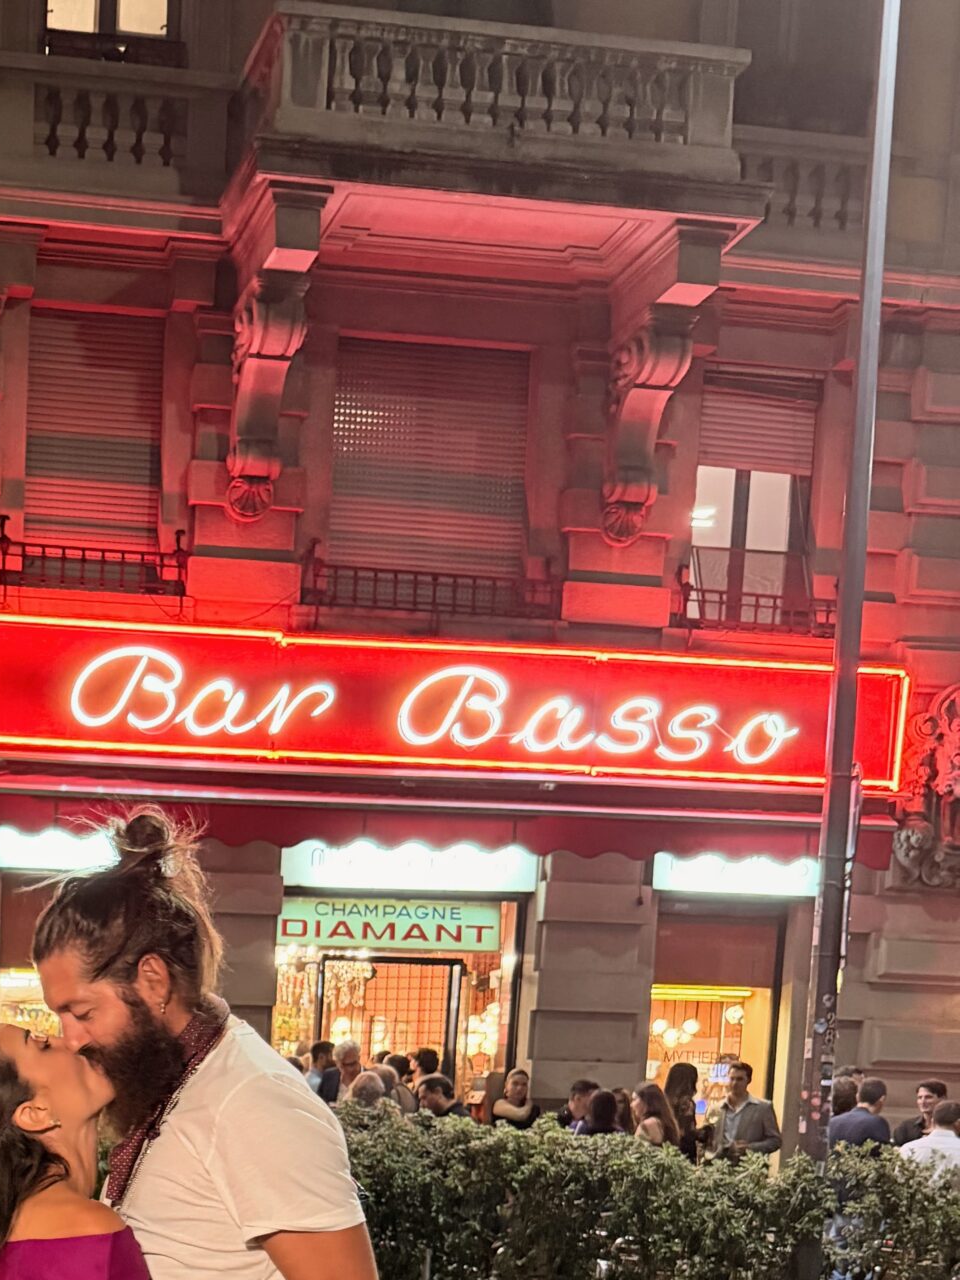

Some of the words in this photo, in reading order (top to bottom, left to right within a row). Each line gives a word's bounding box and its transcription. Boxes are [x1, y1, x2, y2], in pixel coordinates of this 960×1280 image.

[69, 646, 335, 736] Bar
[396, 664, 800, 766] Basso
[314, 901, 463, 921] CHAMPAGNE
[280, 918, 495, 944] DIAMANT
